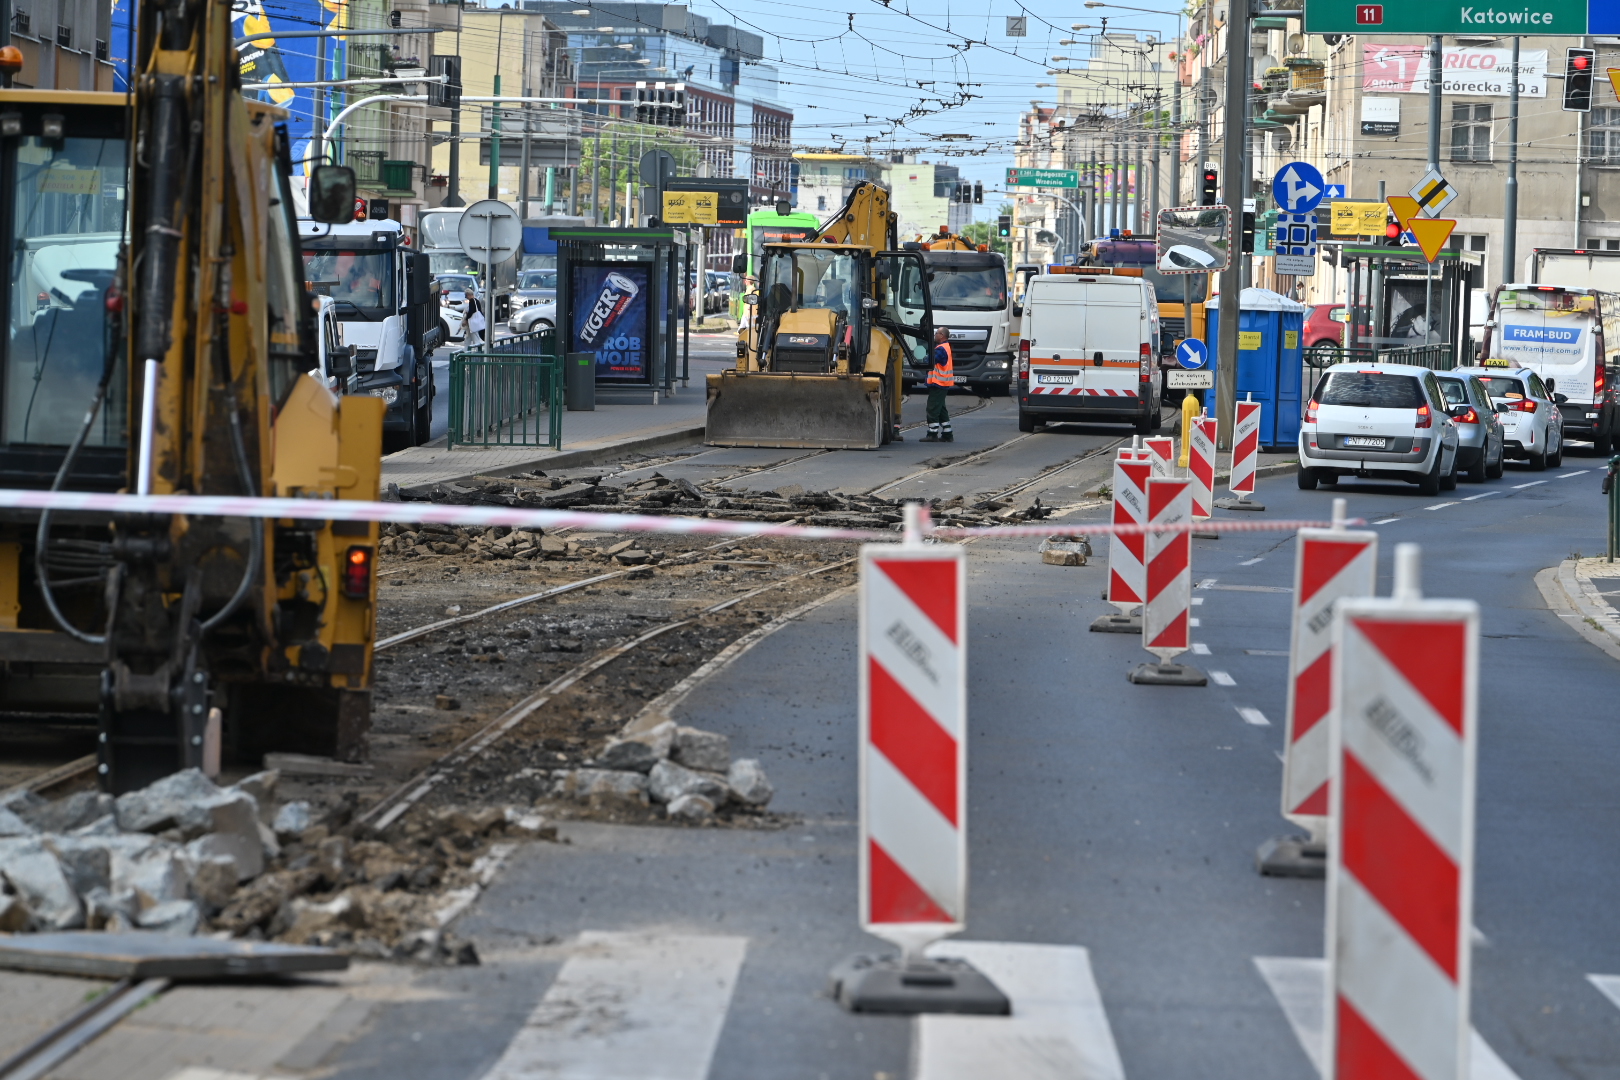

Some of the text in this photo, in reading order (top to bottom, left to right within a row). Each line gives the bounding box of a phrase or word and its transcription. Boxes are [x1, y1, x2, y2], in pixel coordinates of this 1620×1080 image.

[1363, 7, 1553, 25] 11 Katowice
[1428, 53, 1497, 70] RICO
[1496, 65, 1535, 75] MACHÉ
[1442, 80, 1502, 93] Górecka
[1530, 85, 1539, 94] a
[580, 288, 620, 344] TIGER
[1513, 328, 1572, 340] FRAM-BUD
[603, 332, 641, 351] RÓB
[1502, 345, 1581, 356] www.frambud.com.pl
[1347, 437, 1385, 446] PNT 77205
